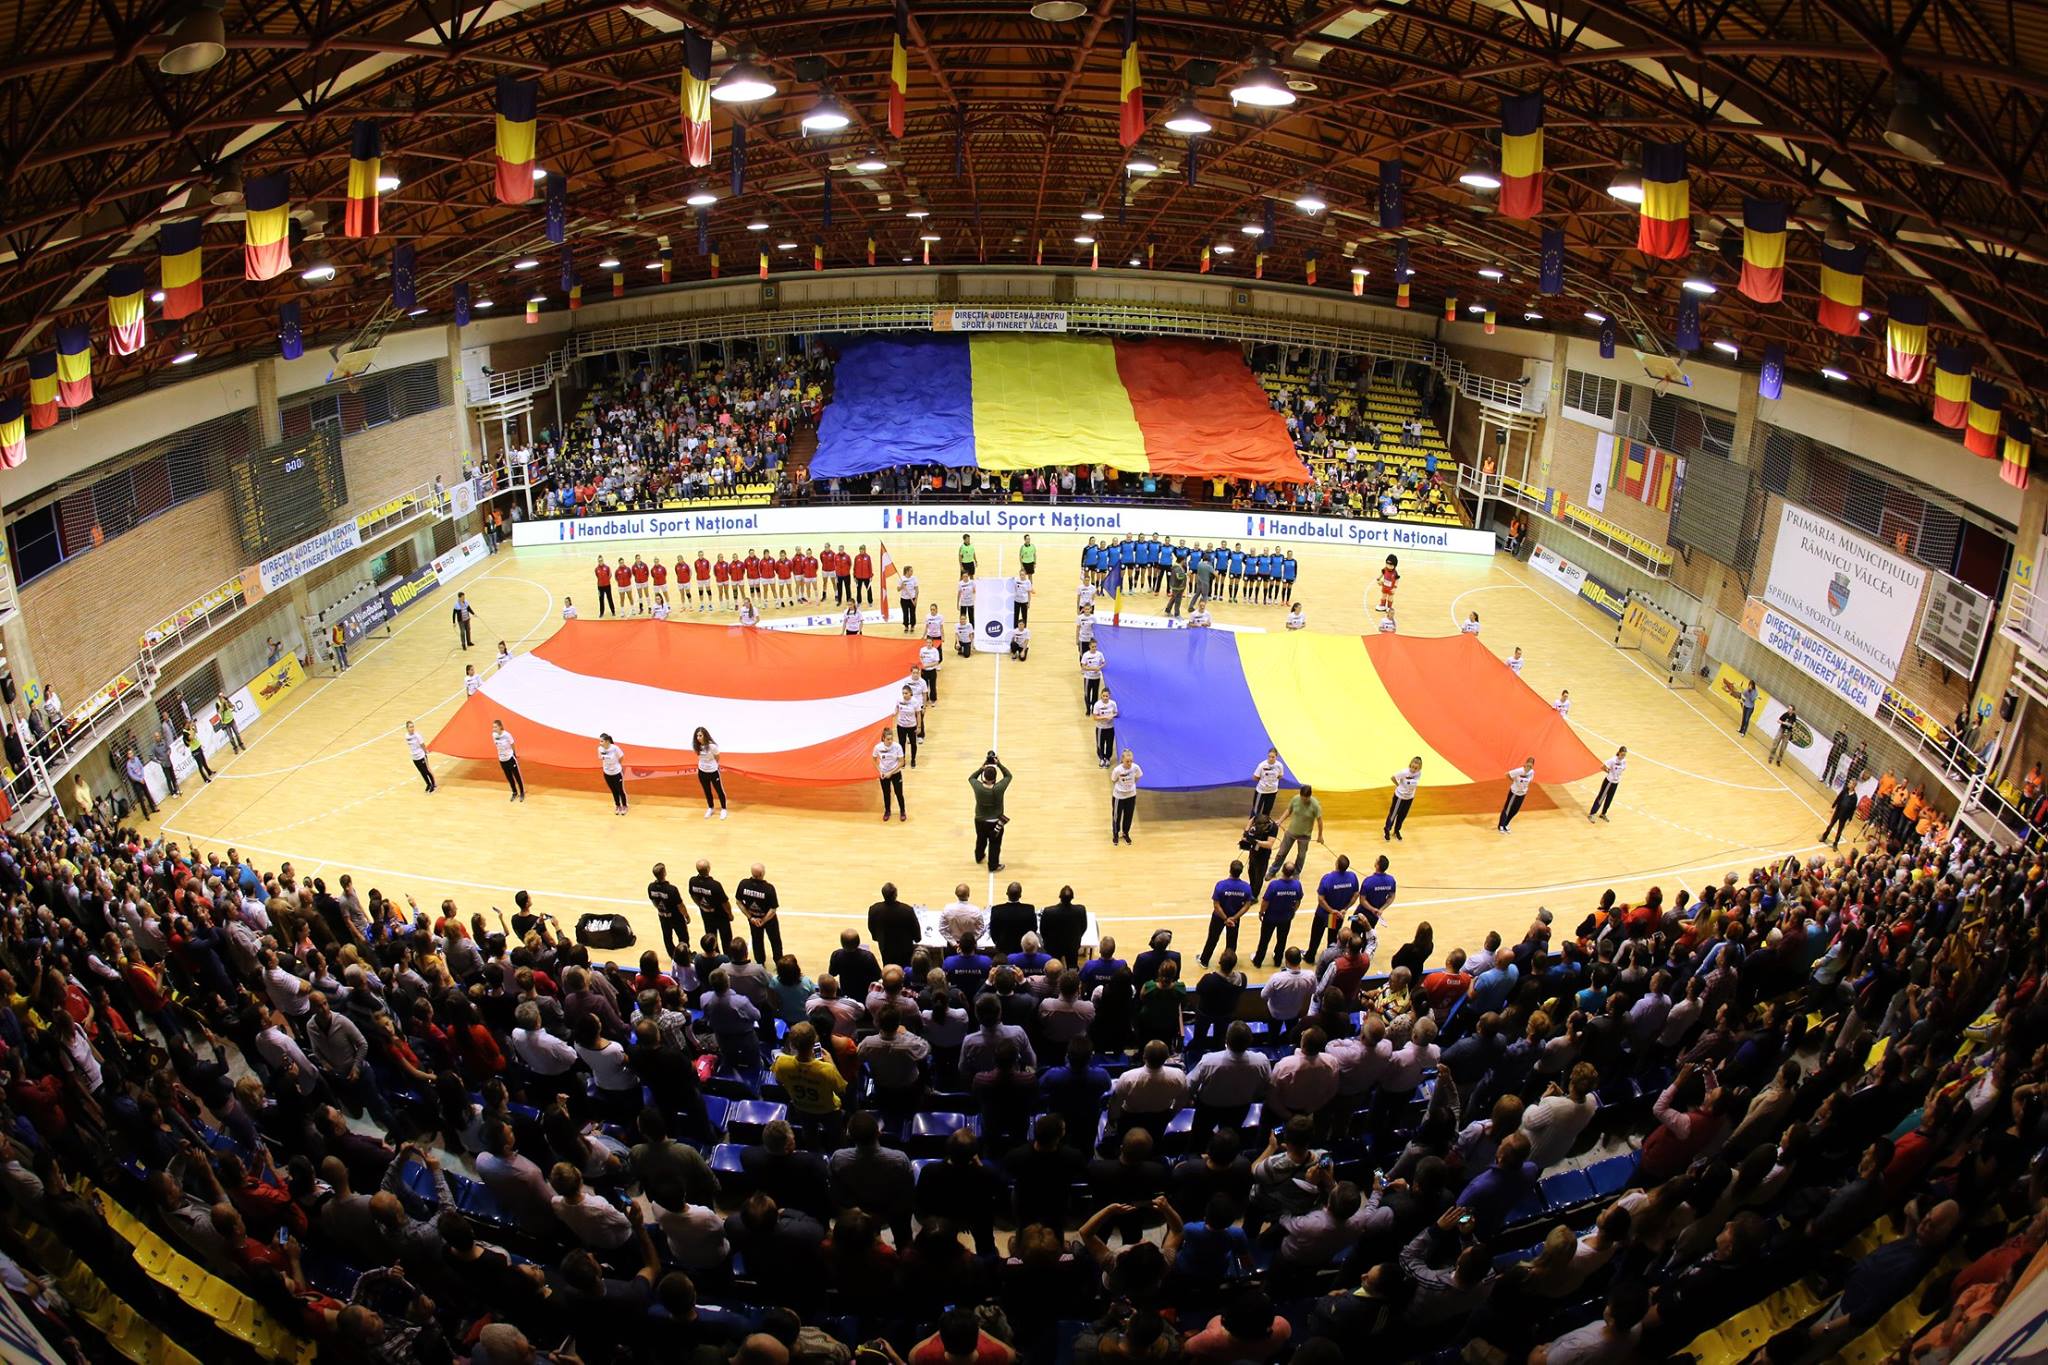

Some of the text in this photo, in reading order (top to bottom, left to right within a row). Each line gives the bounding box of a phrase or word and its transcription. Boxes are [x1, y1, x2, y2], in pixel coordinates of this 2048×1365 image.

[962, 321, 985, 329] SPORT
[997, 321, 1027, 329] TINERET
[578, 519, 644, 536] Handbalul
[650, 518, 690, 536] Sport
[908, 510, 991, 526] Handbalul
[997, 512, 1045, 530] Sport
[1270, 520, 1343, 538] Handbalul
[1349, 525, 1388, 543] Sport
[272, 568, 293, 587] SPORT
[302, 550, 328, 568] TINERET
[1838, 537, 1919, 589] MUNICIPIULUI
[1805, 606, 1842, 635] SPORTUL
[1768, 632, 1794, 656] SPORT
[1804, 654, 1837, 685] TINERET
[743, 888, 765, 899] AUSTRIA
